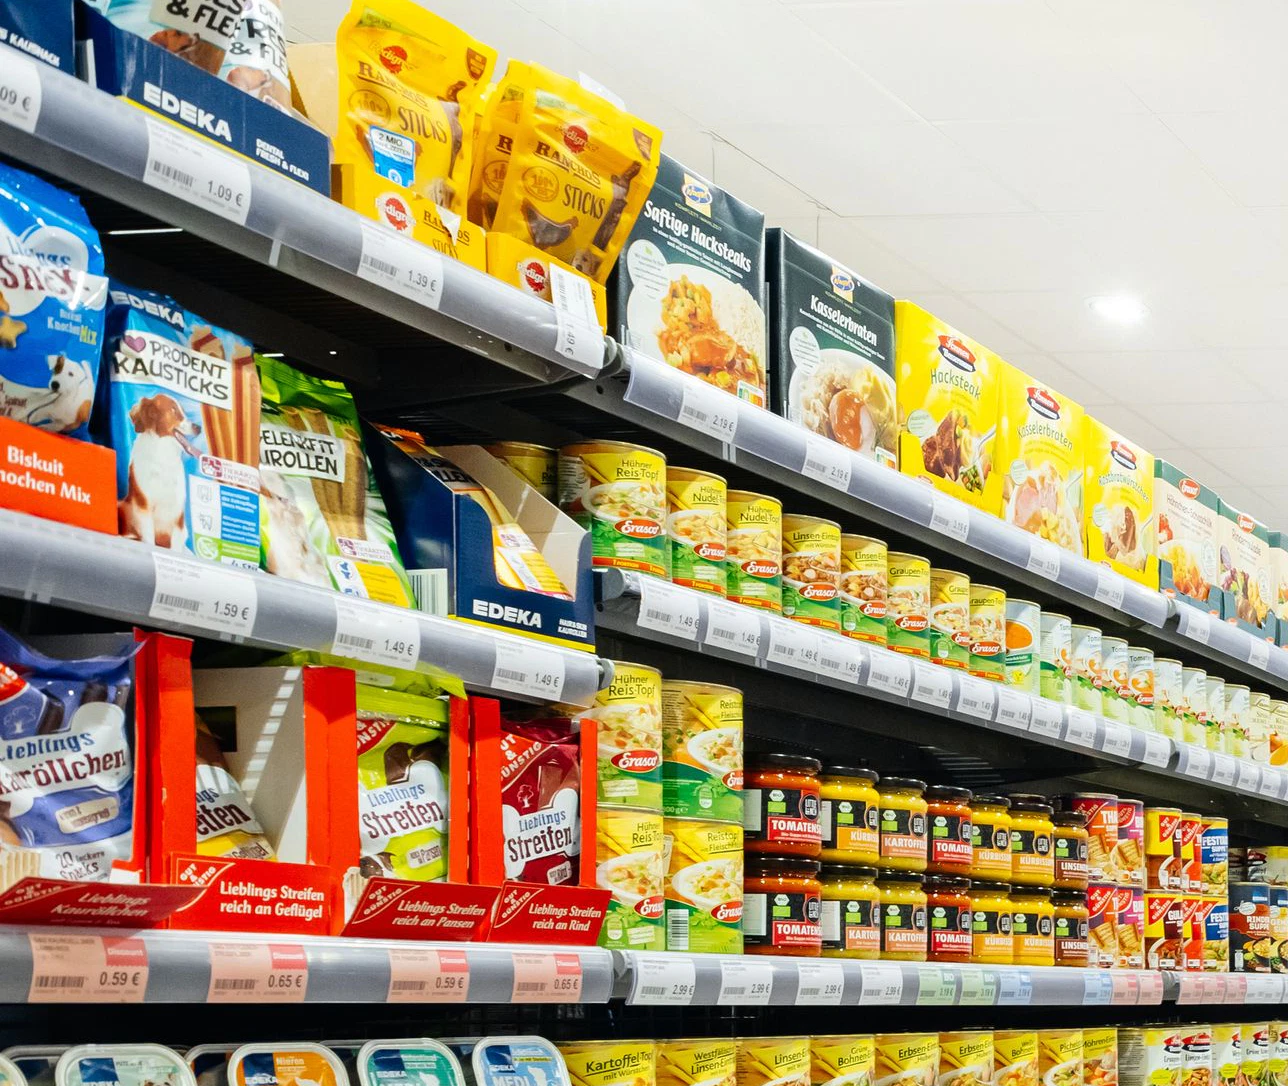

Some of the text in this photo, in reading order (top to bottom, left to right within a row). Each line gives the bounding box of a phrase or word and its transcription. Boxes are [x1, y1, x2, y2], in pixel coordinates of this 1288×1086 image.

[143, 82, 232, 142] EDEKA
[535, 141, 601, 189] RANCHOS
[208, 181, 243, 207] 1.09 €
[562, 183, 605, 219] STICKS
[644, 200, 689, 239] Saftige
[691, 224, 752, 272] Hacksteaks
[408, 268, 438, 292] 1.39 €
[810, 294, 878, 347] Kasselerbraten
[150, 340, 228, 380] PRODENT
[113, 351, 229, 401] KAUSTICKS
[930, 368, 981, 401] Hacksteak
[7, 445, 64, 477] Biskuit
[621, 459, 652, 469] Hühner
[620, 520, 661, 536] Erasco
[745, 561, 778, 576] Erasco
[804, 584, 838, 598] Erasco
[213, 600, 249, 621] 1.59 €
[472, 599, 542, 628] EDEKA
[900, 617, 929, 629] Erasco
[384, 639, 414, 656] 1.49 €
[971, 642, 1001, 655] Erasco
[534, 672, 560, 688] 1.49 €
[614, 675, 649, 685] Hühner
[617, 752, 659, 768] Erasco
[367, 784, 425, 808] Lieblings
[360, 799, 446, 839] Streifen
[518, 810, 567, 833] Lieblings
[507, 826, 573, 863] Streifen
[78, 891, 152, 906] Lieblings
[220, 881, 326, 902] Lieblings Streifen
[50, 903, 149, 918] Kauröllchen
[220, 900, 323, 920] reich an Geflügel
[397, 899, 486, 916] Lieblings Streifen
[529, 903, 602, 919] Lieblings Streifen
[392, 915, 475, 929] reich an Pansen
[533, 919, 591, 931] reich an Rind
[100, 972, 141, 986] 0.59 €
[268, 974, 303, 988] 0.65 €
[436, 977, 464, 990] 0.59 €
[554, 979, 578, 990] 0.65 €
